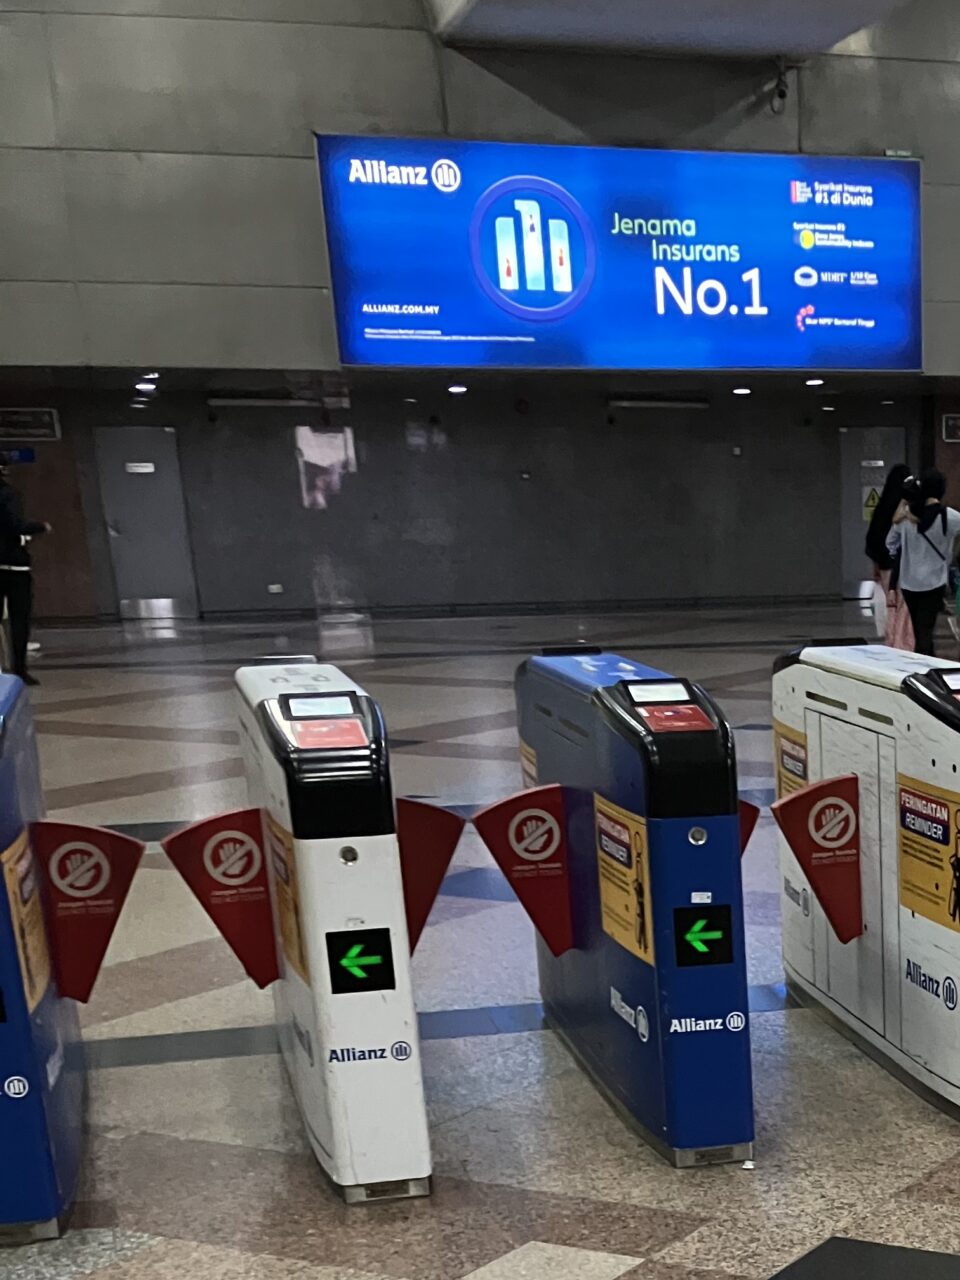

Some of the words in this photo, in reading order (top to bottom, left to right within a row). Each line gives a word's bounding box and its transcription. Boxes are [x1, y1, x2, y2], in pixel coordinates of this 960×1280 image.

[349, 159, 428, 185] Allianz
[830, 193, 841, 204] di
[842, 194, 873, 206] Dunia
[611, 212, 696, 236] Jenama
[652, 239, 740, 262] Insurans
[655, 266, 768, 316] No.1
[362, 304, 439, 314] ALLIANZ.COM.MY
[901, 792, 948, 822] PERINGATAN
[905, 812, 943, 840] REMINDER
[905, 958, 941, 999] Allianz
[669, 1018, 723, 1033] Allianz
[328, 1047, 387, 1063] Allianz
